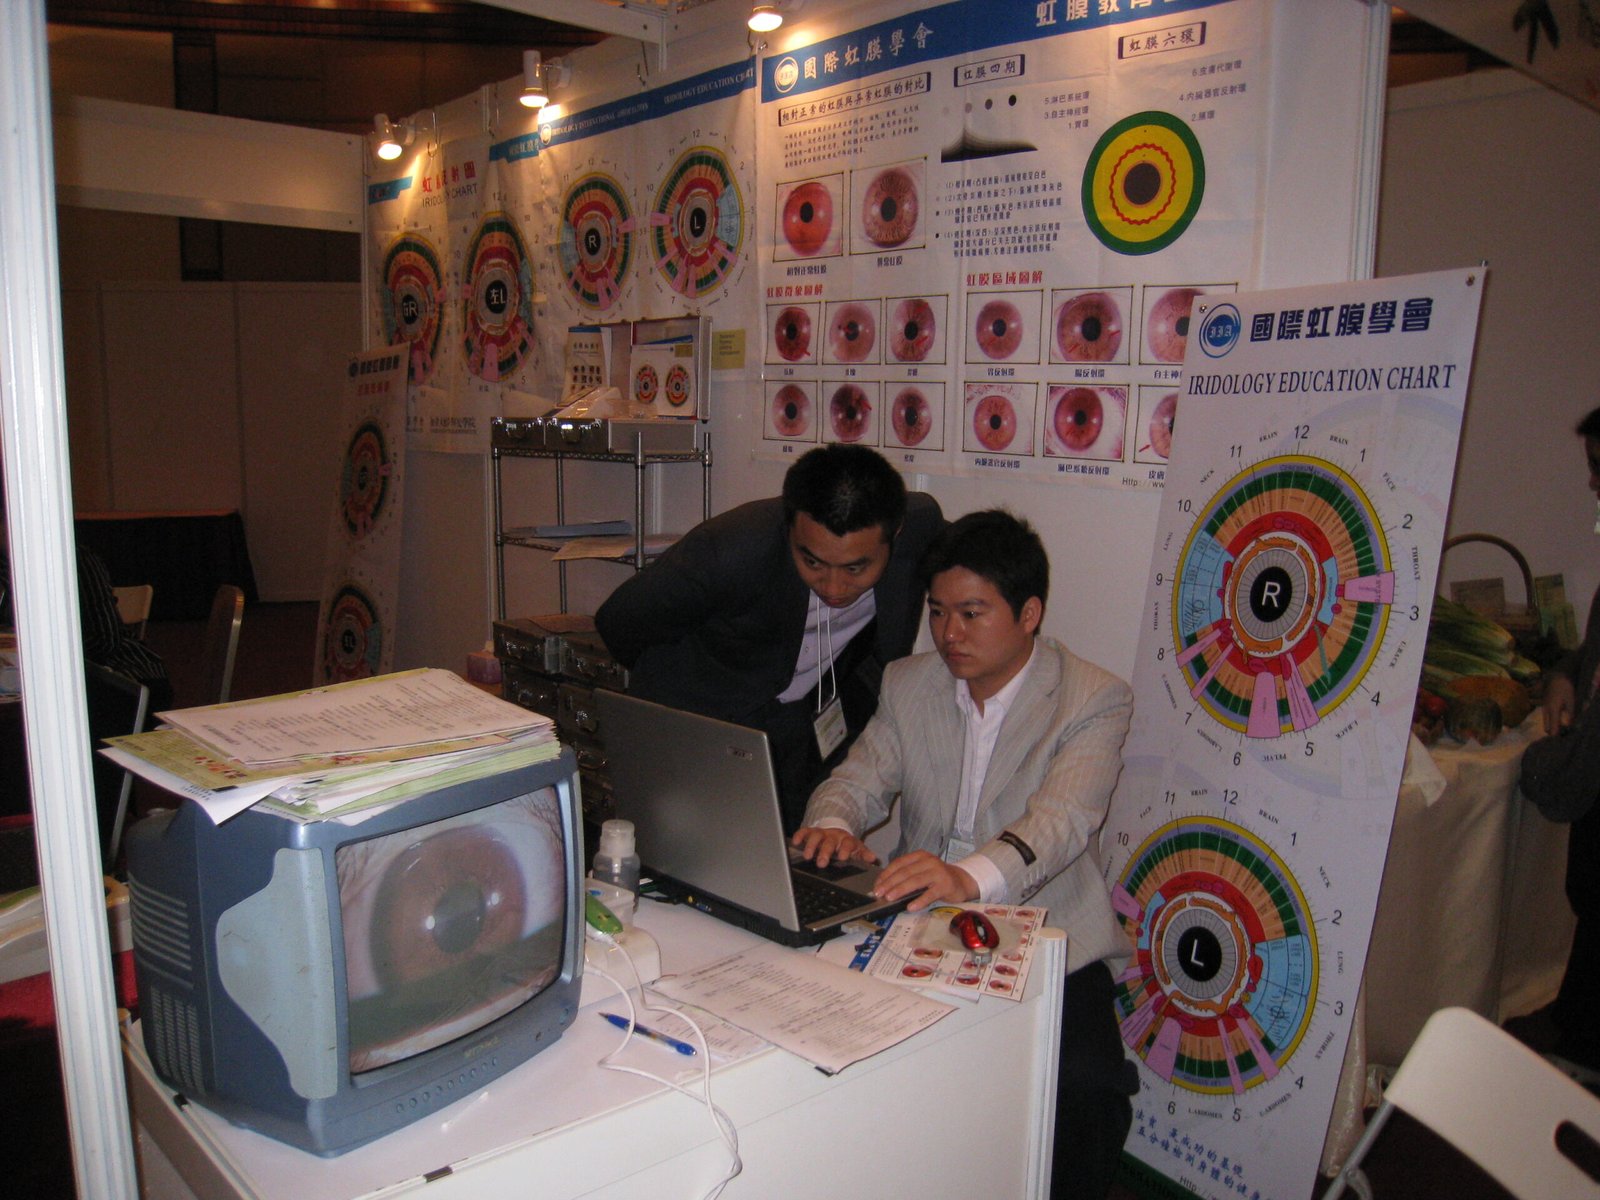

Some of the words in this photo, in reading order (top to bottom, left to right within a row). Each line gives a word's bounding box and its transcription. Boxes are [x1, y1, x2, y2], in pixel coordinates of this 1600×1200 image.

[1128, 28, 1196, 52] 虹膜六環
[804, 22, 934, 79] 國際虹膜學會
[963, 58, 1016, 80] 虹膜四期
[694, 215, 701, 230] L
[588, 235, 598, 248] R
[1249, 296, 1434, 342] 國際虹膜學會
[1188, 372, 1276, 395] IRIDOLOGY
[1278, 367, 1383, 394] EDUCATION
[1386, 364, 1456, 390] CHART
[1259, 431, 1279, 443] BRAIN
[1294, 424, 1310, 440] 12
[1329, 434, 1349, 446] BRAIN
[1230, 445, 1242, 458] 11
[1360, 448, 1367, 463] 1
[1382, 471, 1397, 492] FACE
[1178, 499, 1191, 513] 10
[1402, 513, 1413, 529] 2
[1411, 546, 1420, 581] THROAT
[1155, 573, 1163, 586] 9
[1261, 580, 1282, 608] R
[1409, 605, 1420, 621] 3
[1157, 647, 1165, 661] 8
[1371, 691, 1381, 706] 4
[1185, 712, 1192, 725] 7
[1305, 742, 1315, 756] 5
[1233, 752, 1242, 766] 6
[1164, 790, 1176, 805] 11
[1191, 788, 1208, 797] BRAIN
[1223, 788, 1239, 805] 12
[1259, 808, 1279, 825] BRAIN
[1117, 831, 1129, 847] 10
[1290, 832, 1298, 846] 1
[1319, 865, 1331, 889] NECK
[1331, 909, 1343, 925] 2
[1191, 938, 1205, 966] L
[1334, 1000, 1344, 1016] 3
[1314, 1031, 1335, 1060] THORAX
[1295, 1075, 1304, 1090] 4
[1167, 1101, 1176, 1115] 6
[1232, 1107, 1242, 1122] 5
